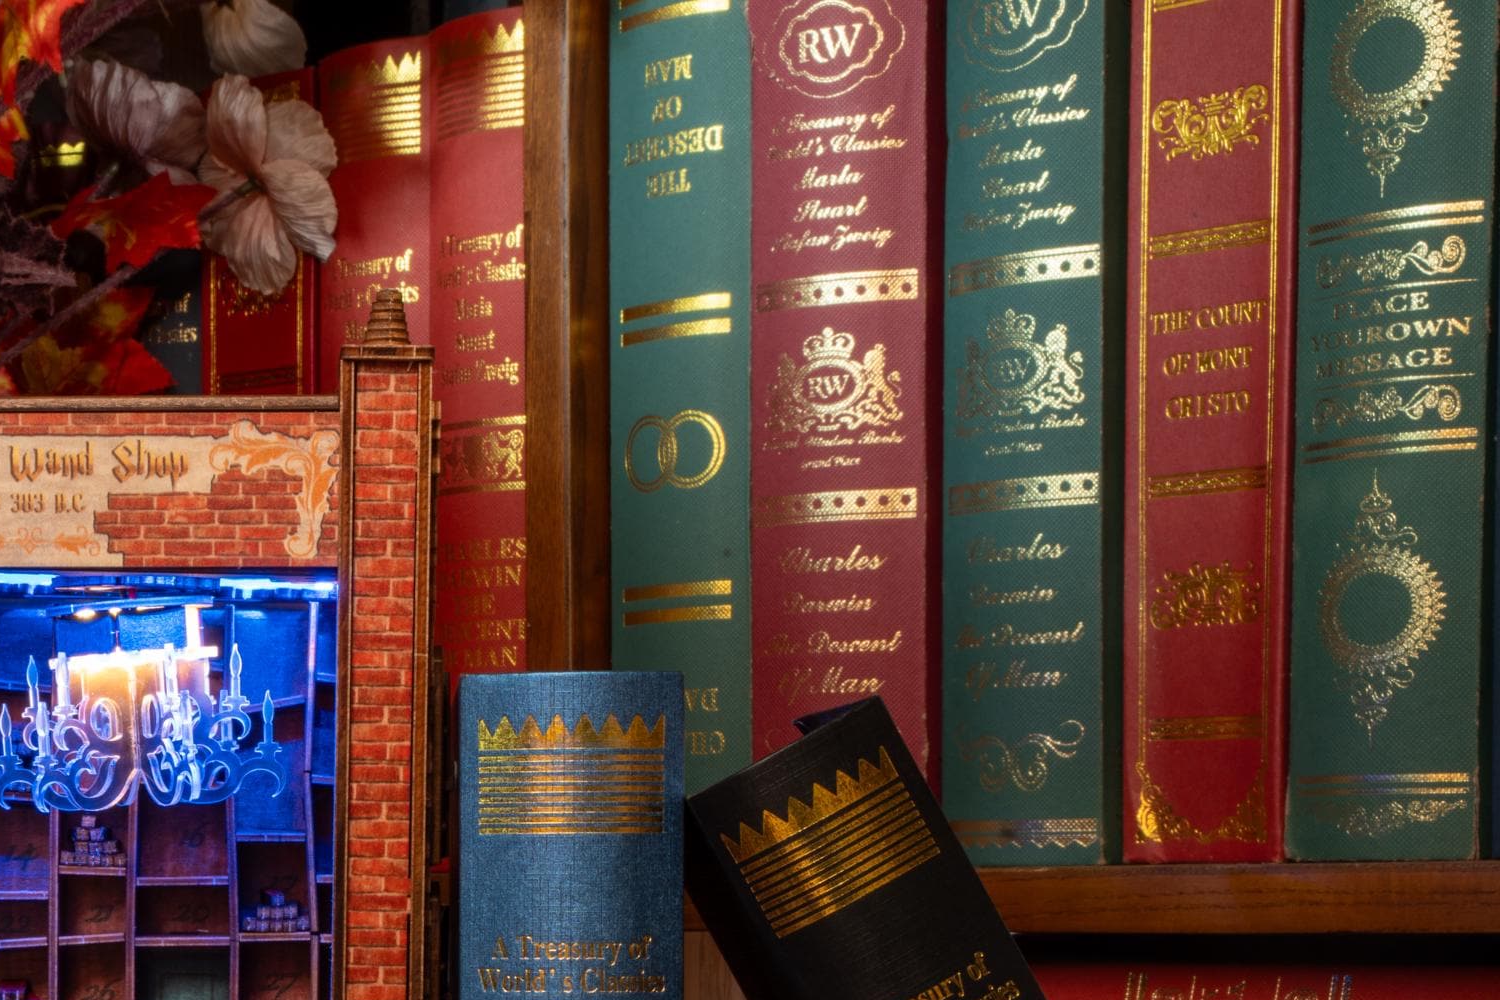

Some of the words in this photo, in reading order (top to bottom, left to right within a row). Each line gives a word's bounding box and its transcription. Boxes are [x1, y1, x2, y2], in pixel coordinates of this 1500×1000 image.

[798, 22, 864, 64] RW
[1052, 73, 1079, 102] of
[505, 223, 524, 248] of
[395, 248, 413, 272] of
[1150, 310, 1193, 335] THE
[1196, 300, 1267, 329] COUNT
[1333, 291, 1430, 321] PLACE
[1162, 353, 1191, 377] OF
[1315, 347, 1453, 379] MESSAGE
[808, 374, 850, 399] RW
[1164, 390, 1251, 420] CRISTO
[8, 441, 95, 482] Wand
[110, 439, 190, 491] Shop
[491, 936, 509, 960] A
[517, 935, 623, 967] Treasury
[629, 934, 653, 960] of
[581, 967, 667, 994] Classics
[966, 951, 991, 981] of
